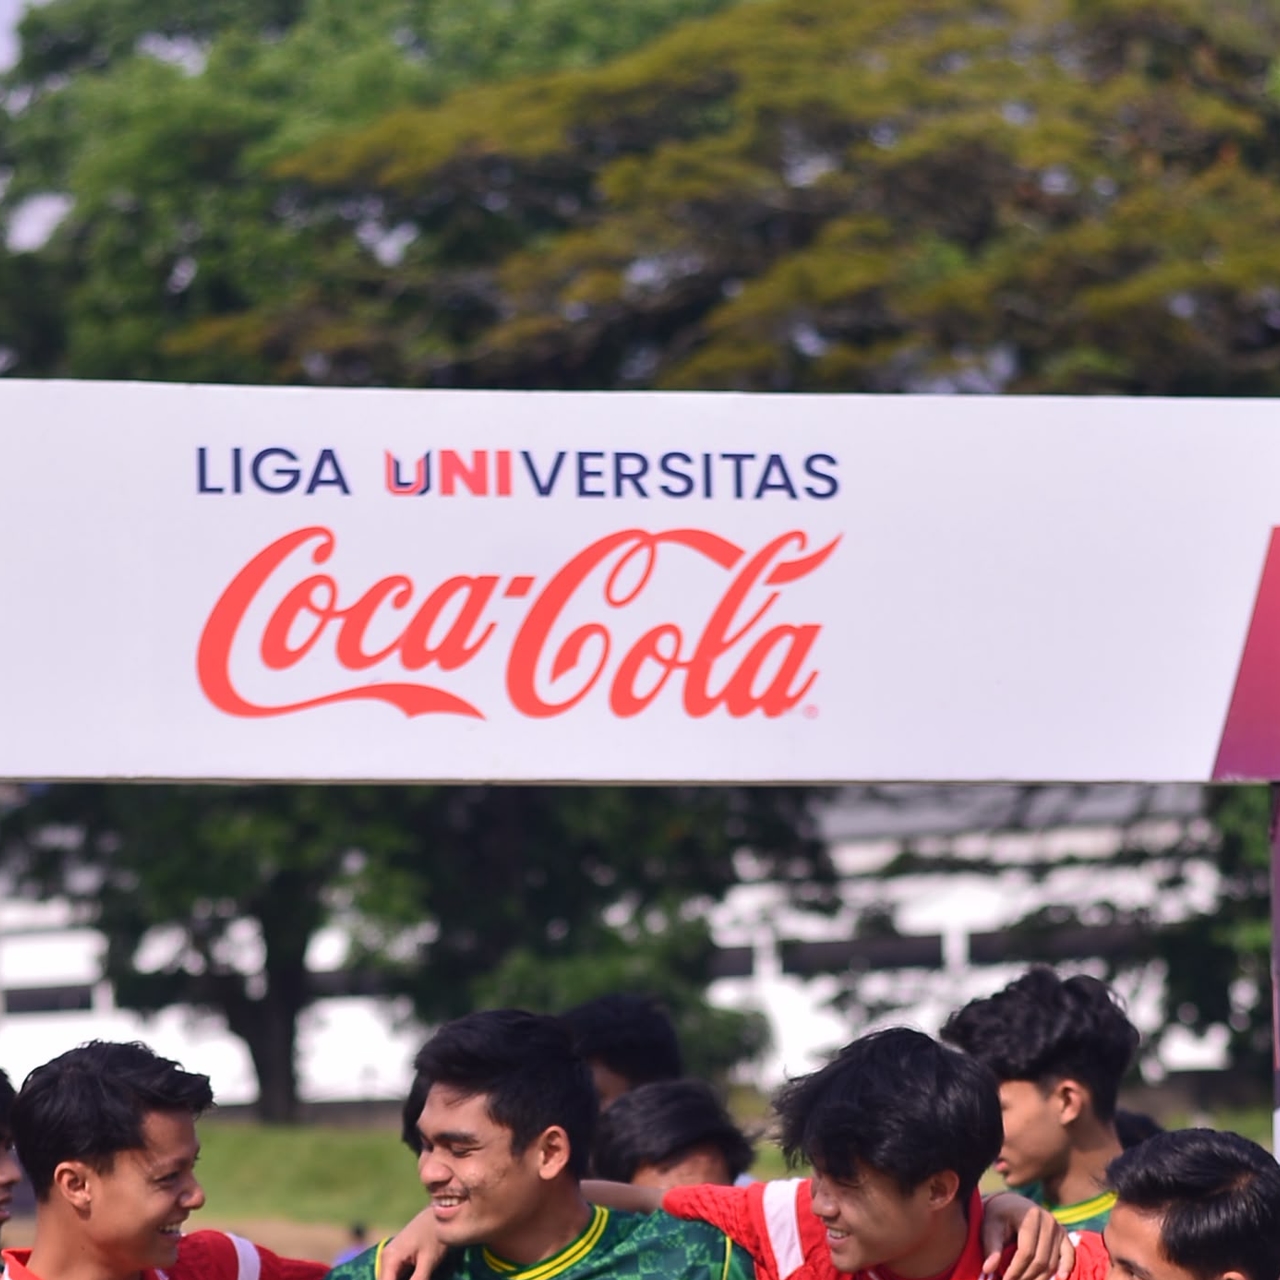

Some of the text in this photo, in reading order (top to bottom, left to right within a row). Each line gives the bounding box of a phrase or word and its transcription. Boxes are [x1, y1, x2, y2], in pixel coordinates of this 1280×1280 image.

[196, 446, 841, 500] LIGA UNIVERSITAS
[195, 525, 845, 721] Coca-Cola
